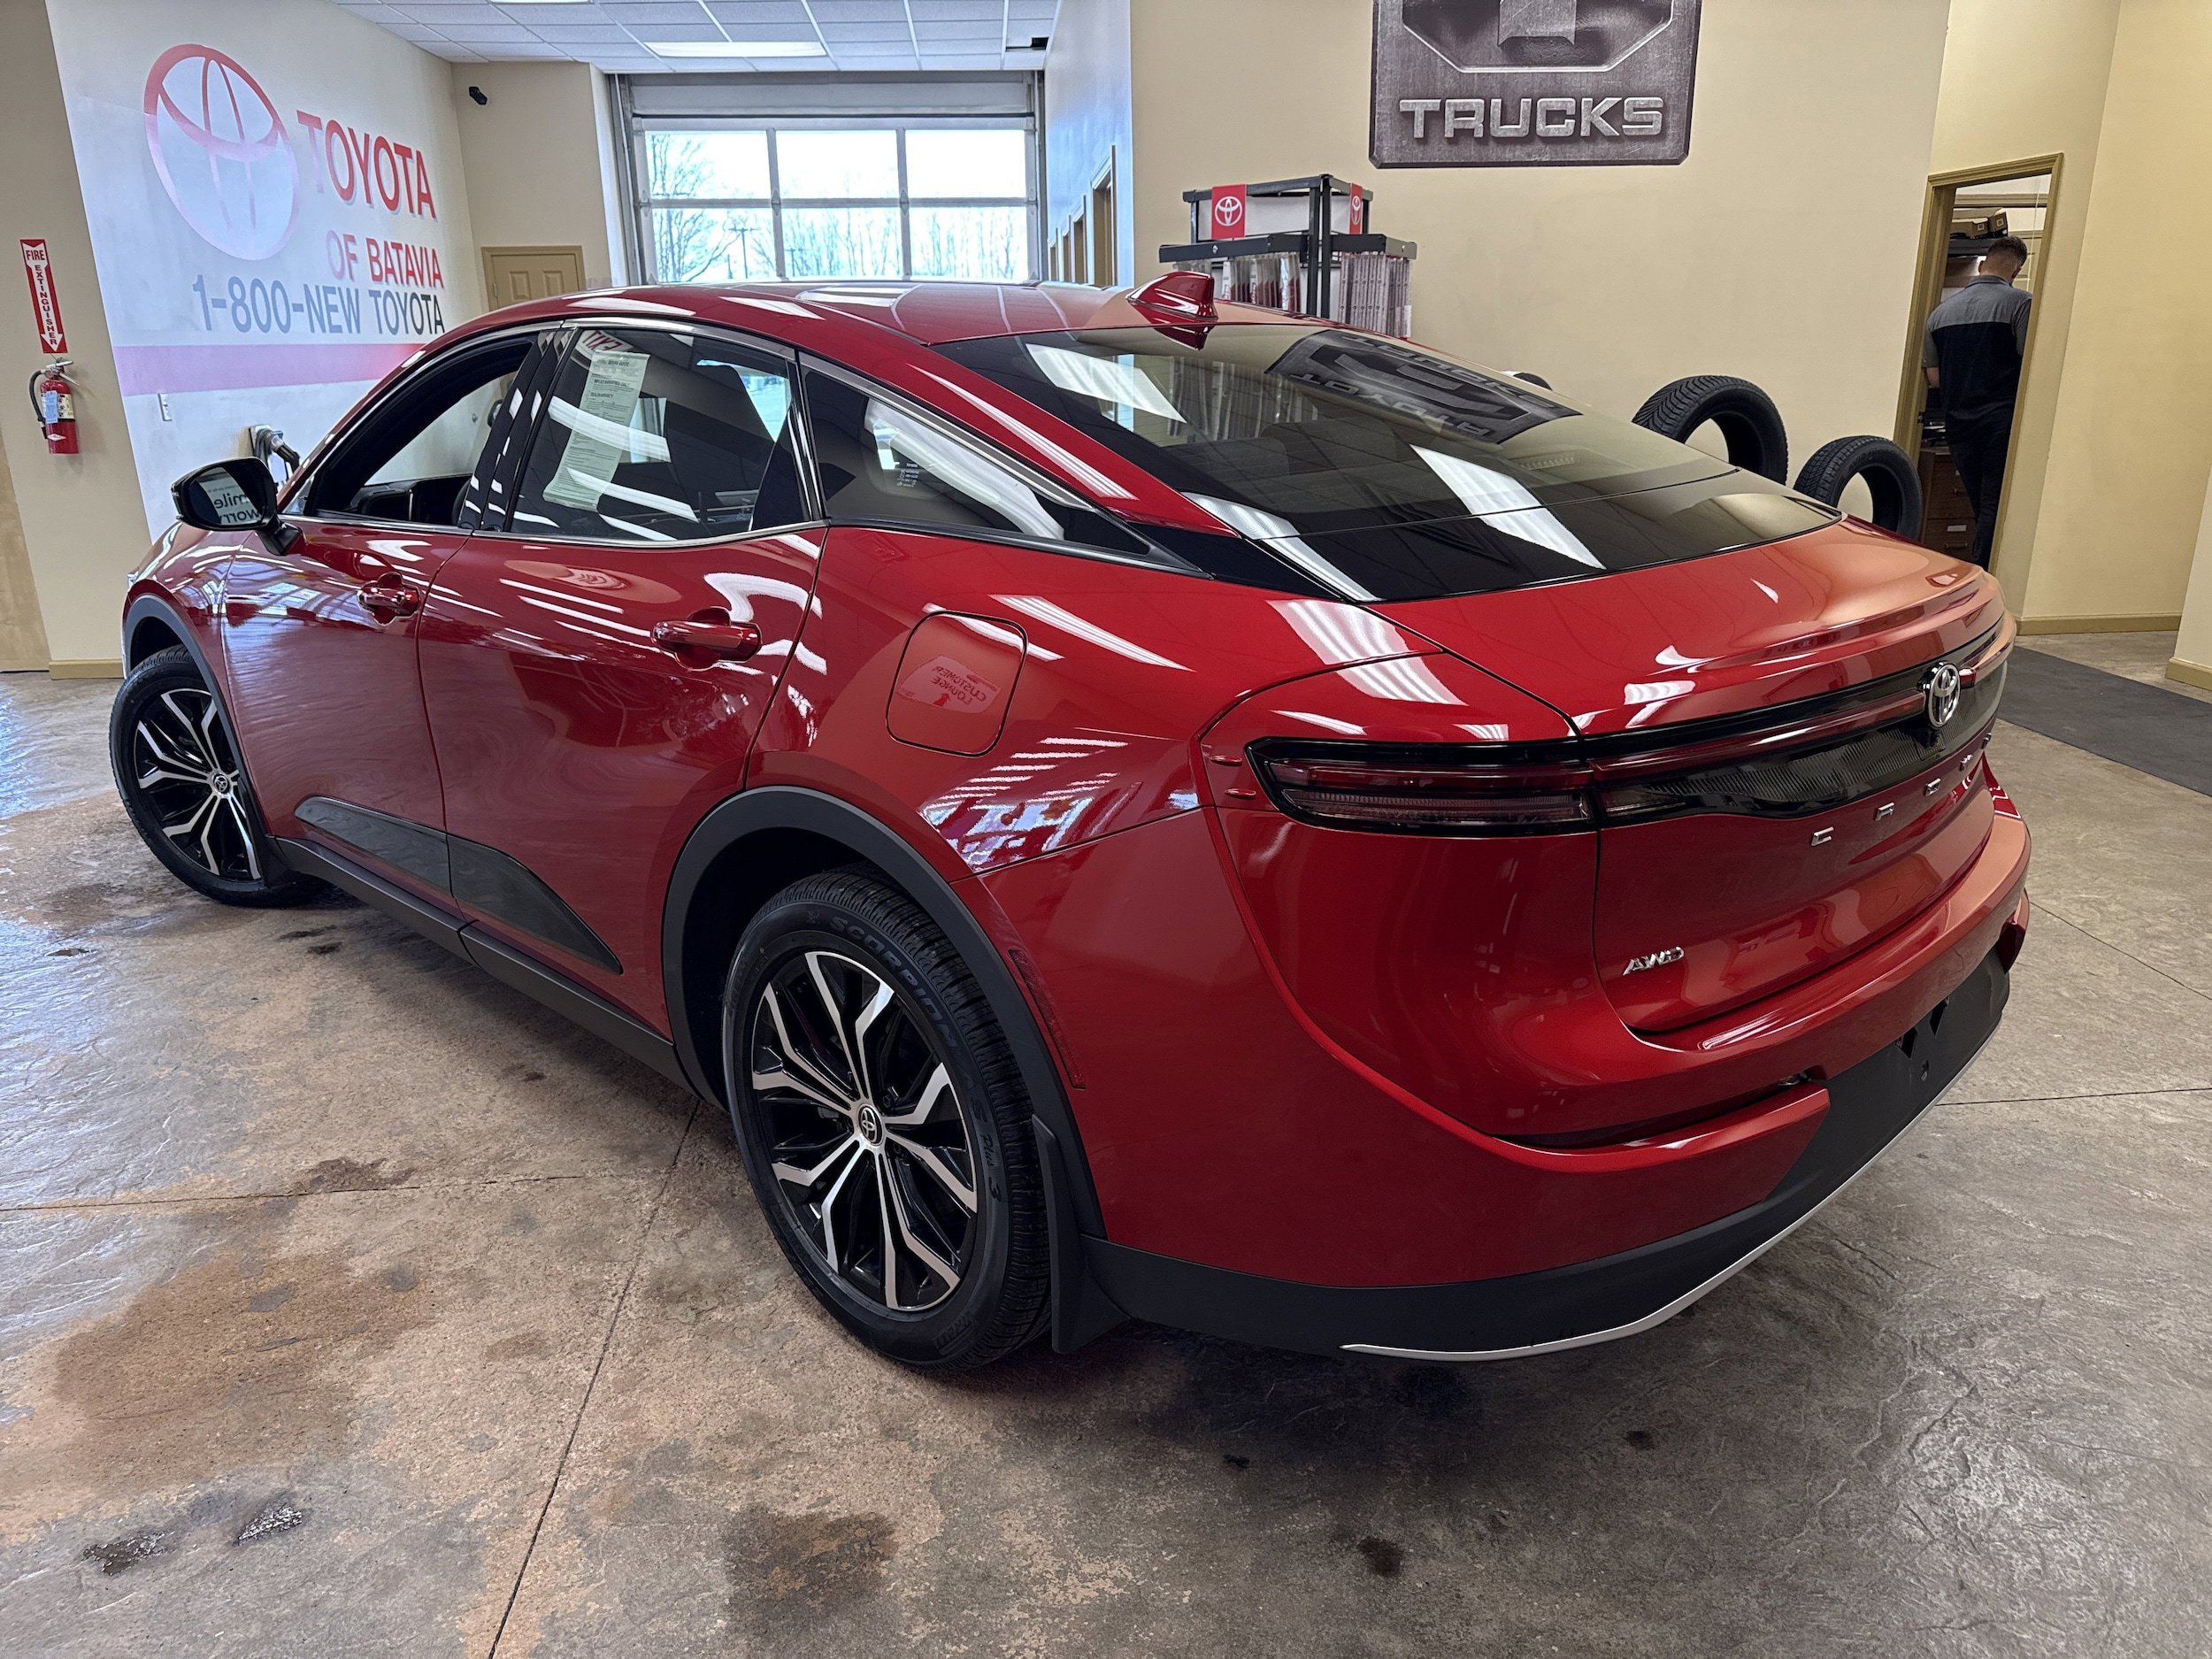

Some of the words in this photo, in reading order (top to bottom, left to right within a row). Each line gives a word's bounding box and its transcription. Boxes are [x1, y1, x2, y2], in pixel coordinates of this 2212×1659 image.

[1399, 96, 1664, 140] TRUCKS
[296, 110, 437, 219] TOYOTA
[26, 250, 45, 261] FIRE
[326, 229, 358, 280] OF
[365, 237, 445, 289] BATAVIA
[35, 265, 58, 346] EXTINGUISHER
[192, 274, 361, 334] 1-800-NEW
[368, 288, 446, 335] TOYOTA
[830, 916, 958, 1048] SCORPION
[1623, 946, 1685, 976] AWD
